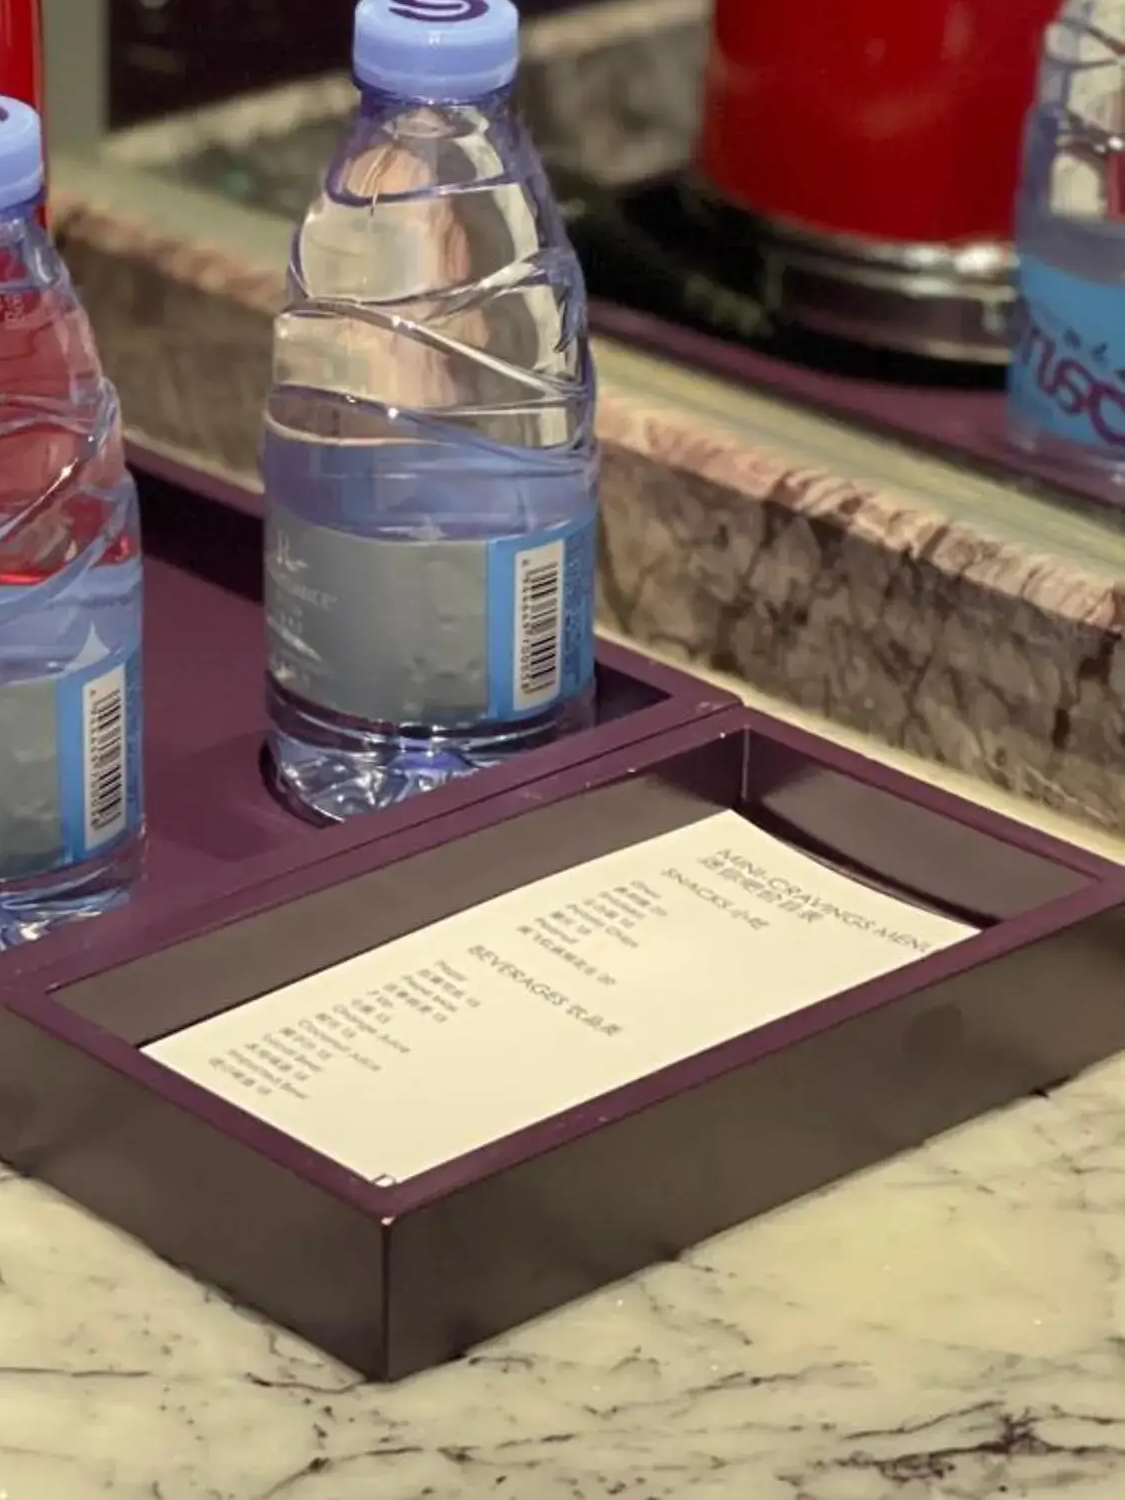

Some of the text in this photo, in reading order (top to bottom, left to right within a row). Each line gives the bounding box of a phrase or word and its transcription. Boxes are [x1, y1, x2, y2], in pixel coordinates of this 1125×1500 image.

[660, 867, 735, 910] SNACKS
[716, 849, 875, 931] MINI-CRAVINGS
[467, 944, 569, 1006] BEVERAGES
